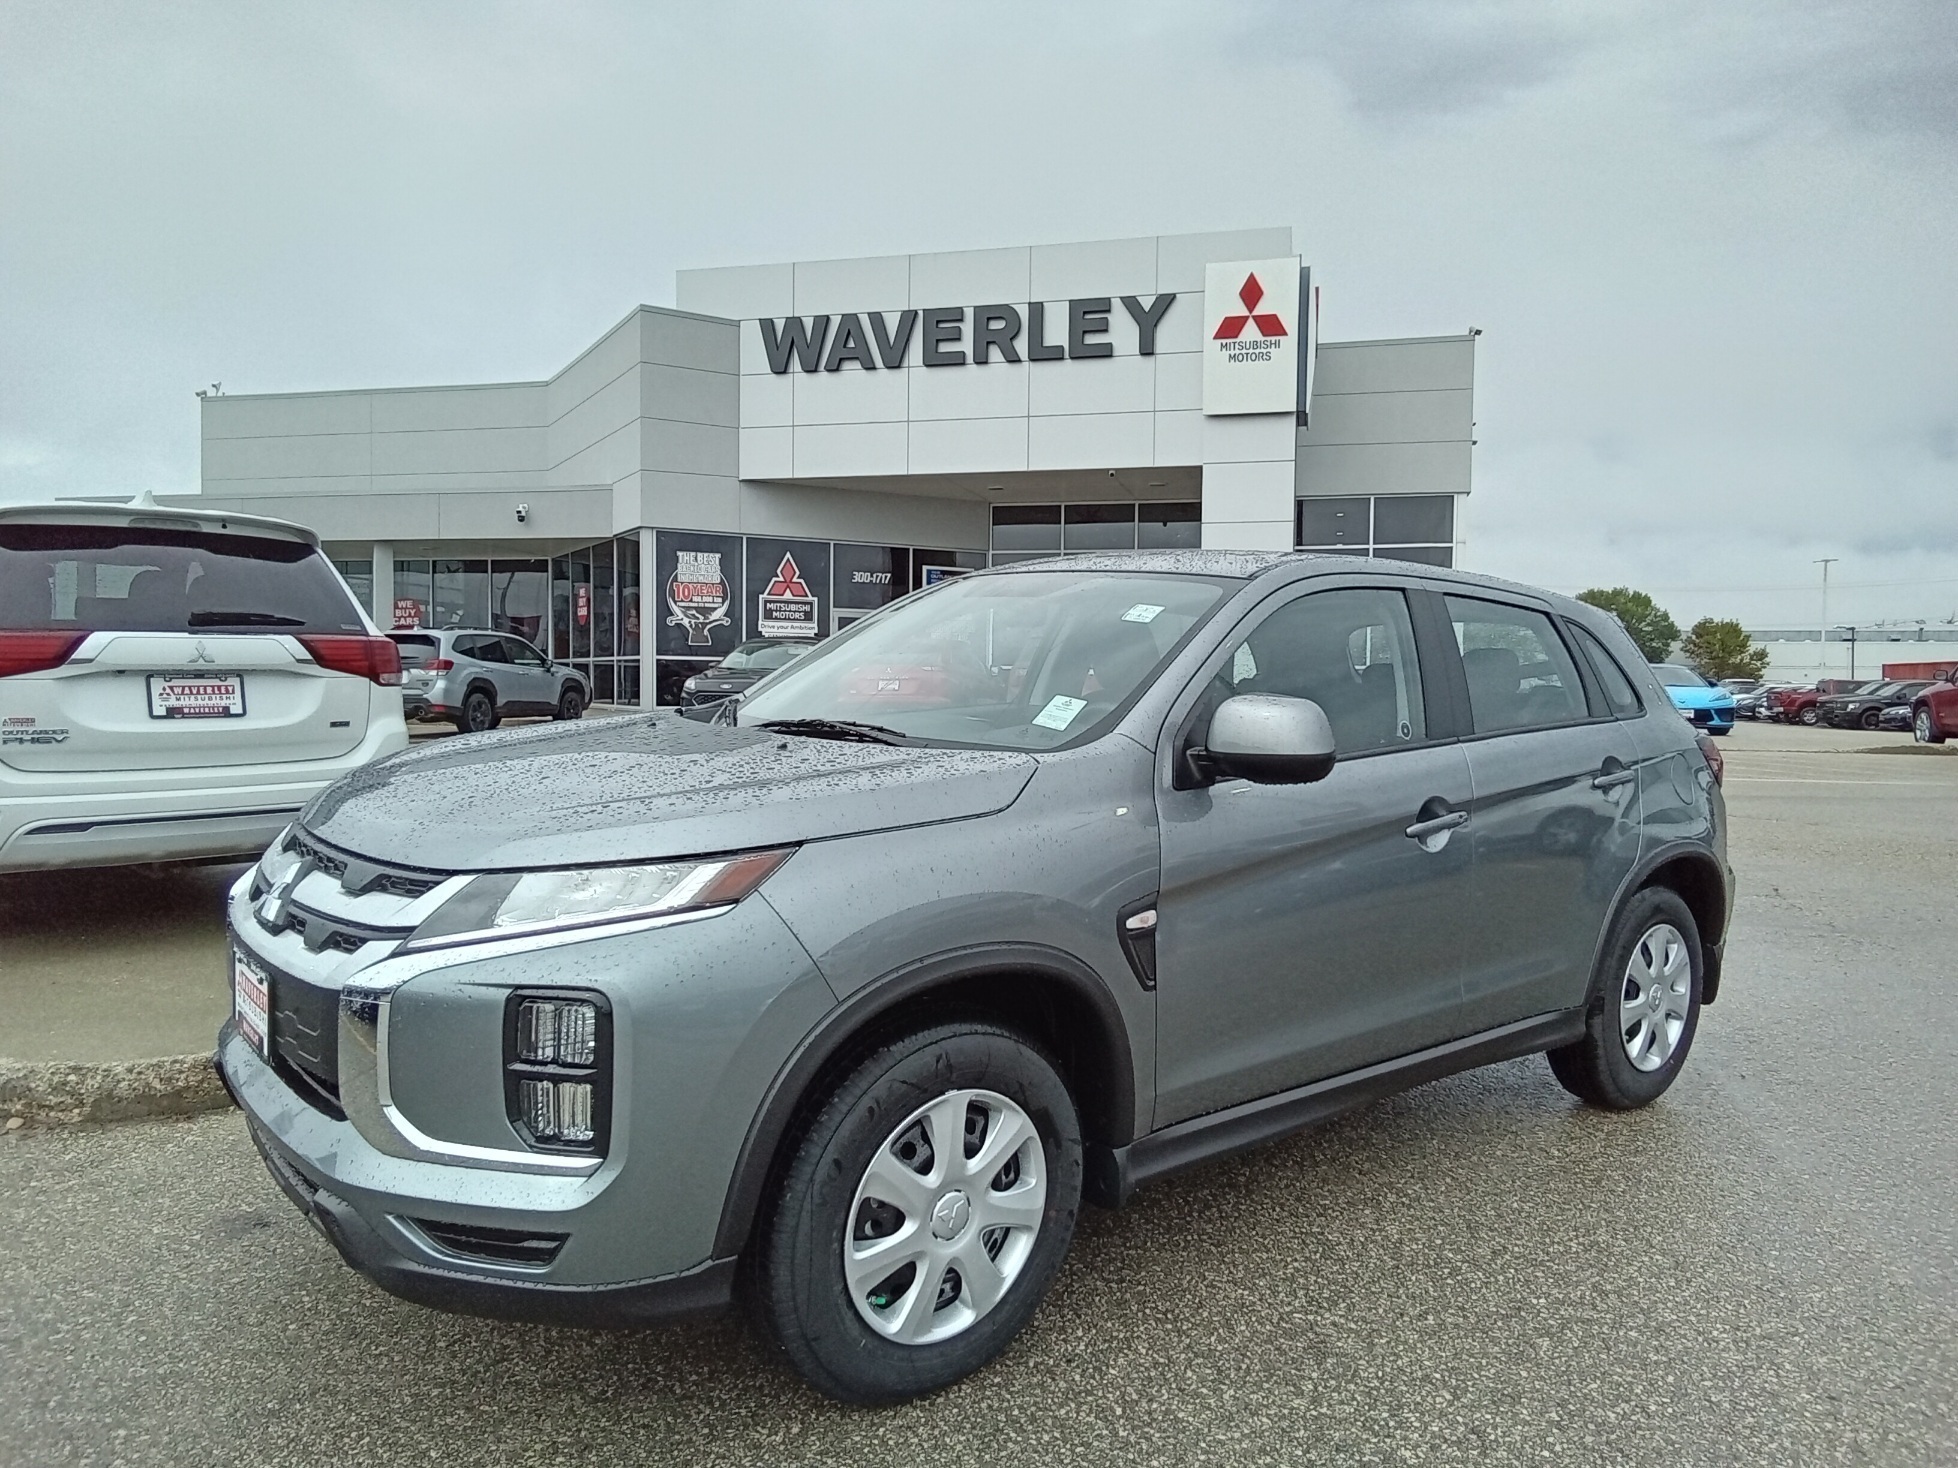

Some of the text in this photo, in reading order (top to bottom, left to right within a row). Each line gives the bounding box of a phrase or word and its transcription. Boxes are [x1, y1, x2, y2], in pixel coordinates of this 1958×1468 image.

[758, 293, 1177, 374] WAVERLEY
[1219, 339, 1281, 352] MITSUBISHI
[1228, 351, 1272, 363] MOTORS
[676, 551, 721, 566] THE BEST
[852, 571, 892, 584] 300-1717
[673, 582, 723, 602] 10 YEAR
[397, 600, 414, 609] WE
[766, 602, 811, 612] MITSUBISHI
[395, 608, 417, 617] BUY
[772, 611, 805, 620] MOTORS
[393, 617, 420, 626] CARS
[172, 685, 235, 695] WAVERLEY
[2, 736, 71, 745] PHEV
